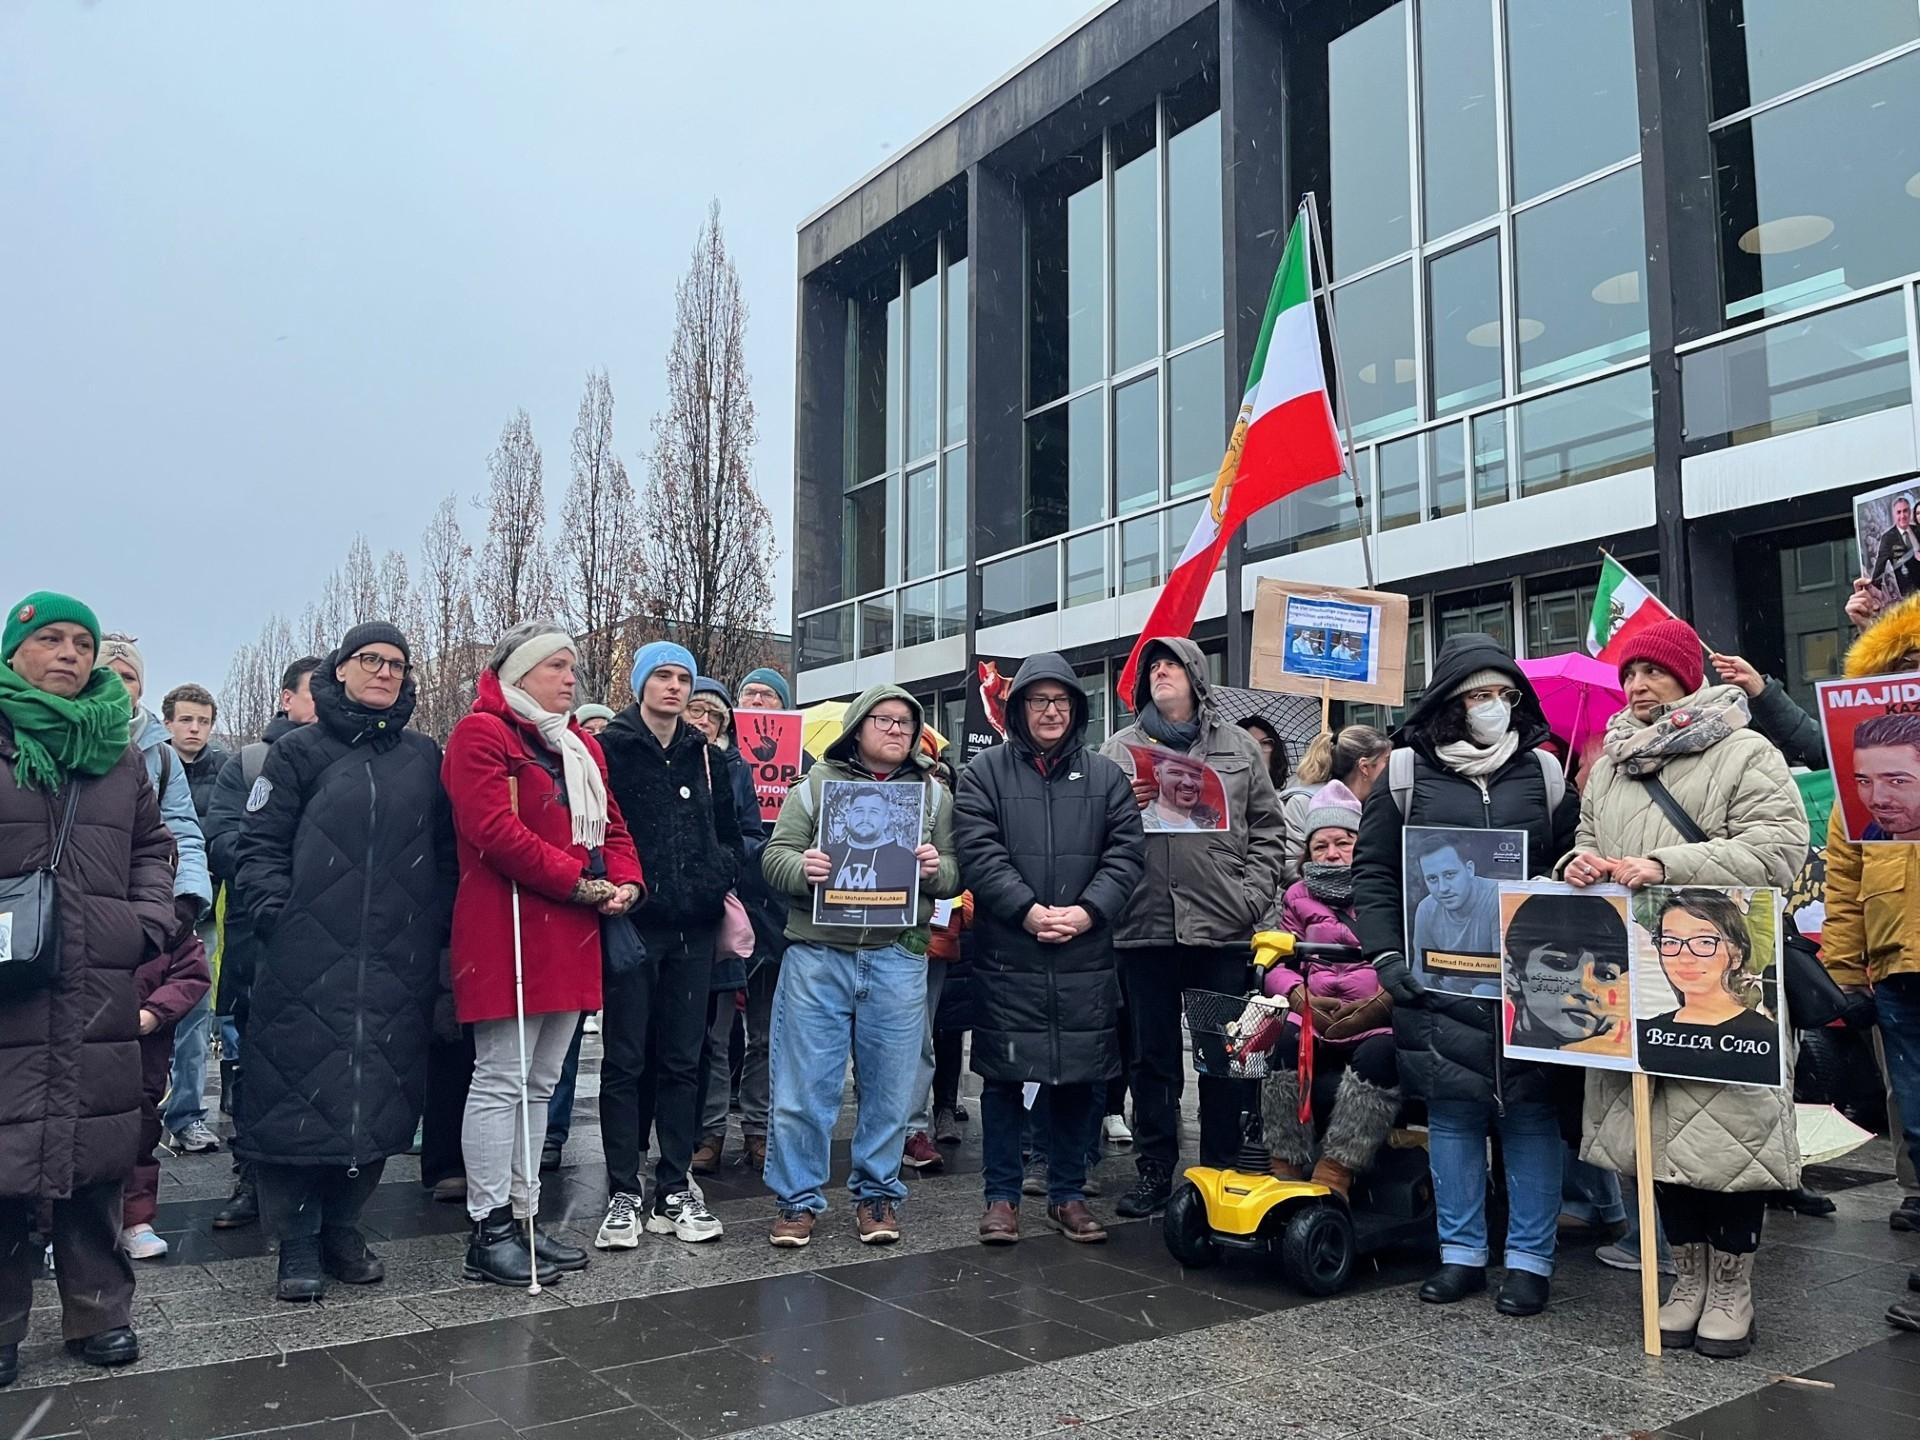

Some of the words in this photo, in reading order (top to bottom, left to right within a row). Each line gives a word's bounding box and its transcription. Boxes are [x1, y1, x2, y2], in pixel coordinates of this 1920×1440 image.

[1828, 683, 1920, 708] MAJID
[968, 733, 992, 745] IRAN
[749, 763, 797, 782] TOP
[754, 783, 788, 794] UTION
[1475, 961, 1498, 969] Amani
[1646, 1028, 1713, 1050] BELLA
[1720, 1035, 1770, 1055] CIAO
